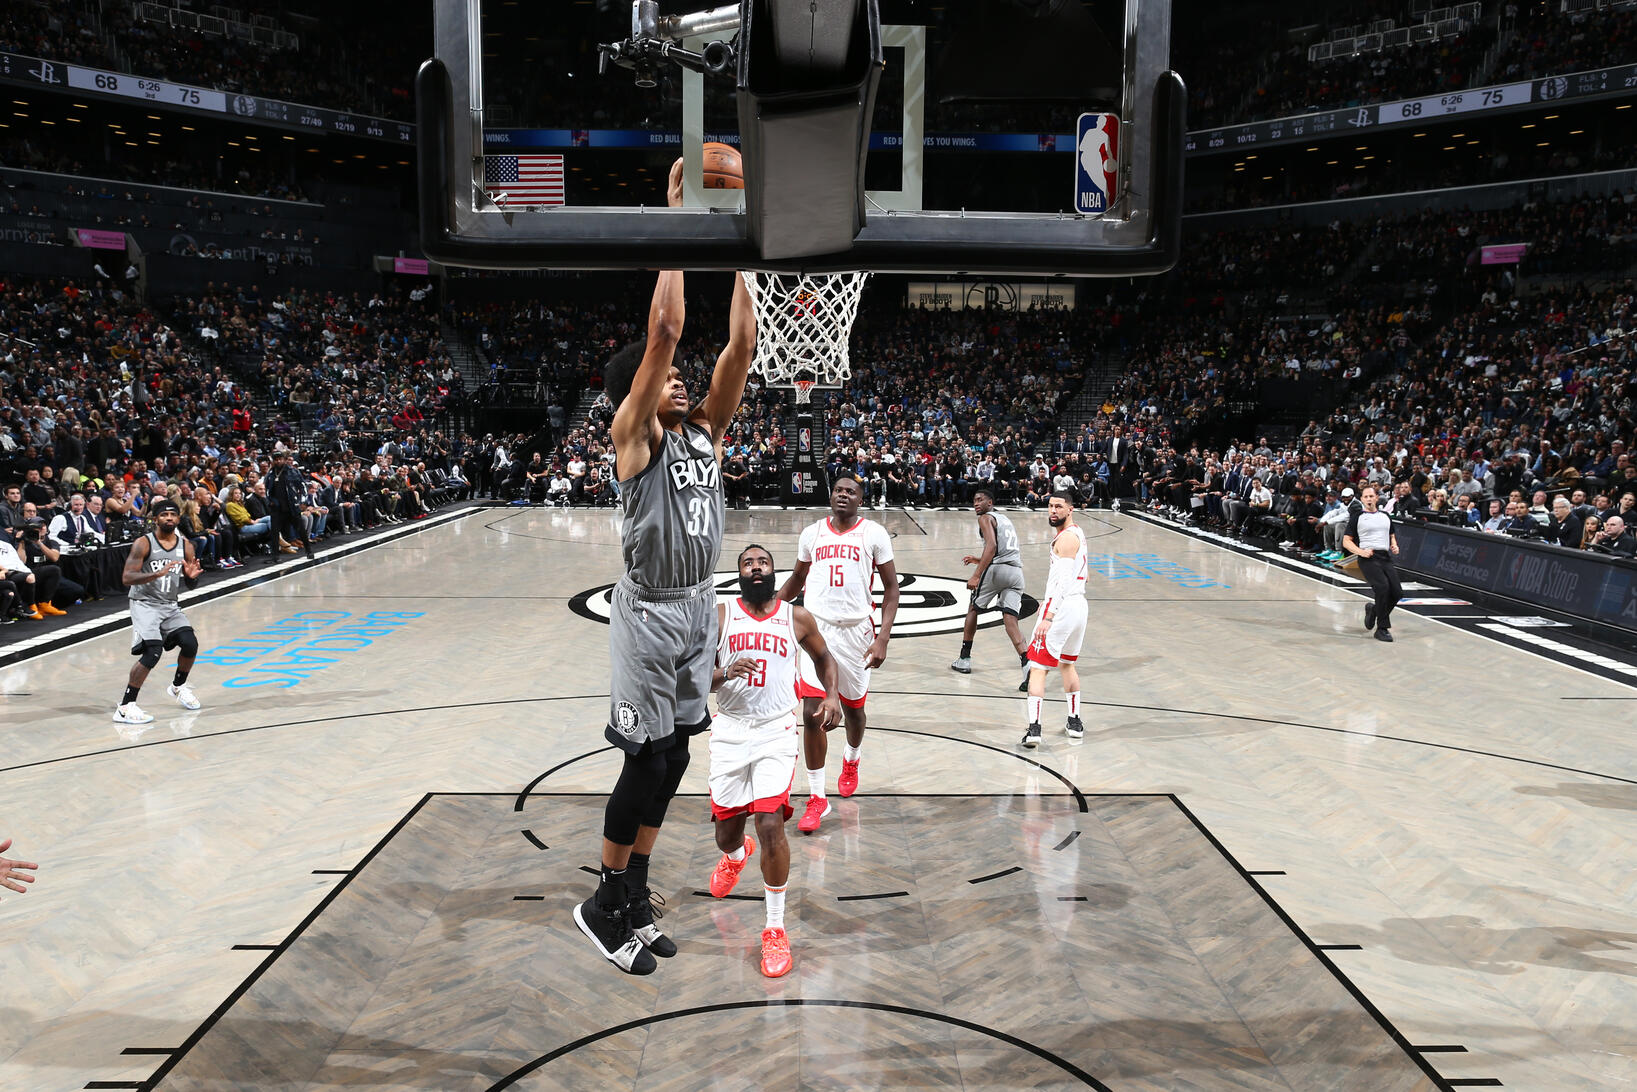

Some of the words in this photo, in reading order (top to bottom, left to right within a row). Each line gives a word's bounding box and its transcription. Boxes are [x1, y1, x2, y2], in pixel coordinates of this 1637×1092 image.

[95, 74, 118, 91] 68
[138, 80, 160, 92] 6:26
[179, 88, 200, 105] 75
[1441, 95, 1463, 106] 6:26
[1481, 89, 1503, 106] 75
[1401, 102, 1422, 118] 68
[650, 134, 663, 143] RED
[665, 134, 681, 143] BULL
[883, 136, 897, 145] RED
[936, 137, 951, 146] YOU
[1081, 191, 1102, 209] NBA
[687, 497, 710, 536] 31
[815, 544, 860, 562] ROCKETS
[1442, 538, 1478, 564] Jersey
[829, 565, 844, 587] 15
[1435, 556, 1489, 582] Assurance
[160, 575, 172, 593] 11
[1515, 556, 1544, 595] NBA
[1543, 559, 1579, 602] Store
[221, 611, 428, 689] BARCLAYS
[728, 632, 788, 658] ROCKETS
